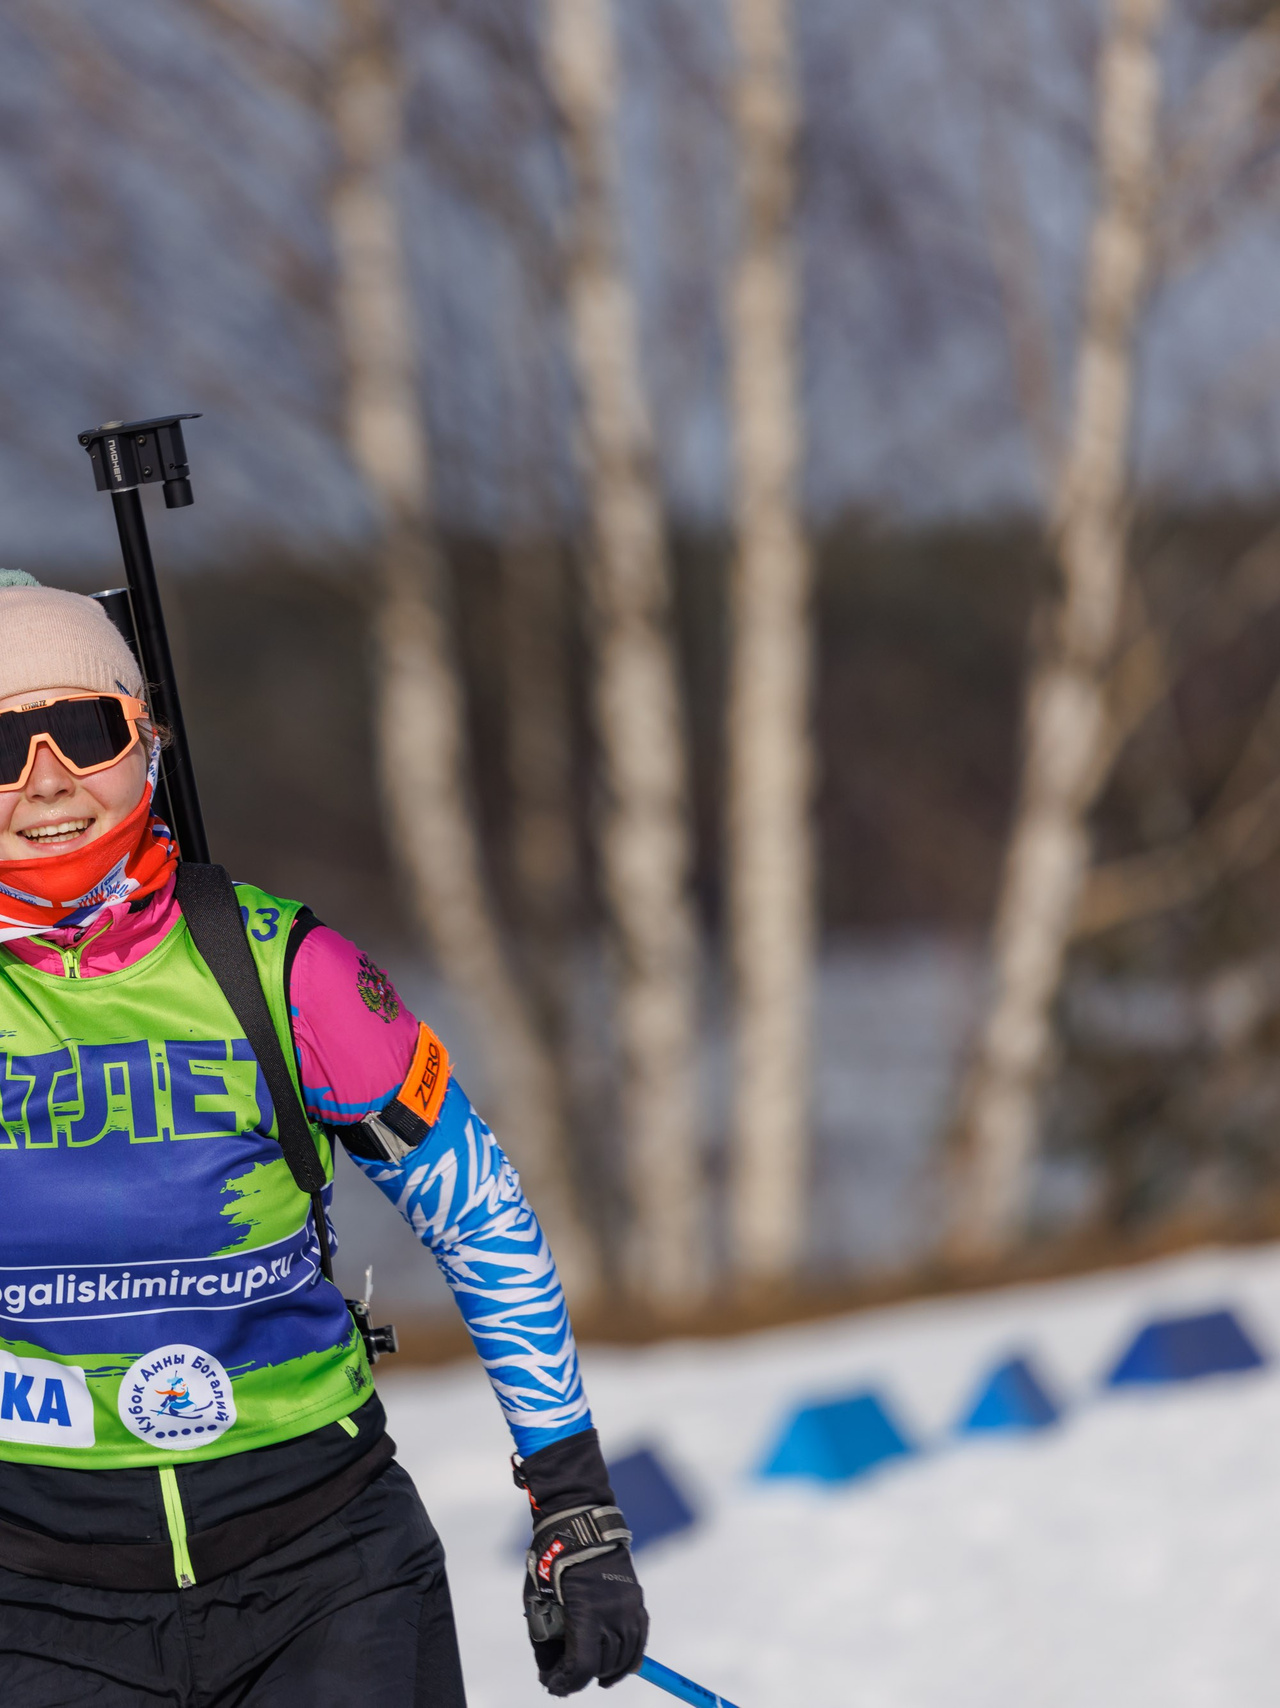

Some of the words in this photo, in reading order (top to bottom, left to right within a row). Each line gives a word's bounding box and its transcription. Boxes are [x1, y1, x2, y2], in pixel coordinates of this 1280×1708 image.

[108, 440, 122, 482] ПИОНЕР
[414, 1042, 440, 1112] ZERO
[140, 1354, 185, 1383] Анны
[191, 1355, 230, 1422] Богалий
[128, 1384, 156, 1434] Кубок
